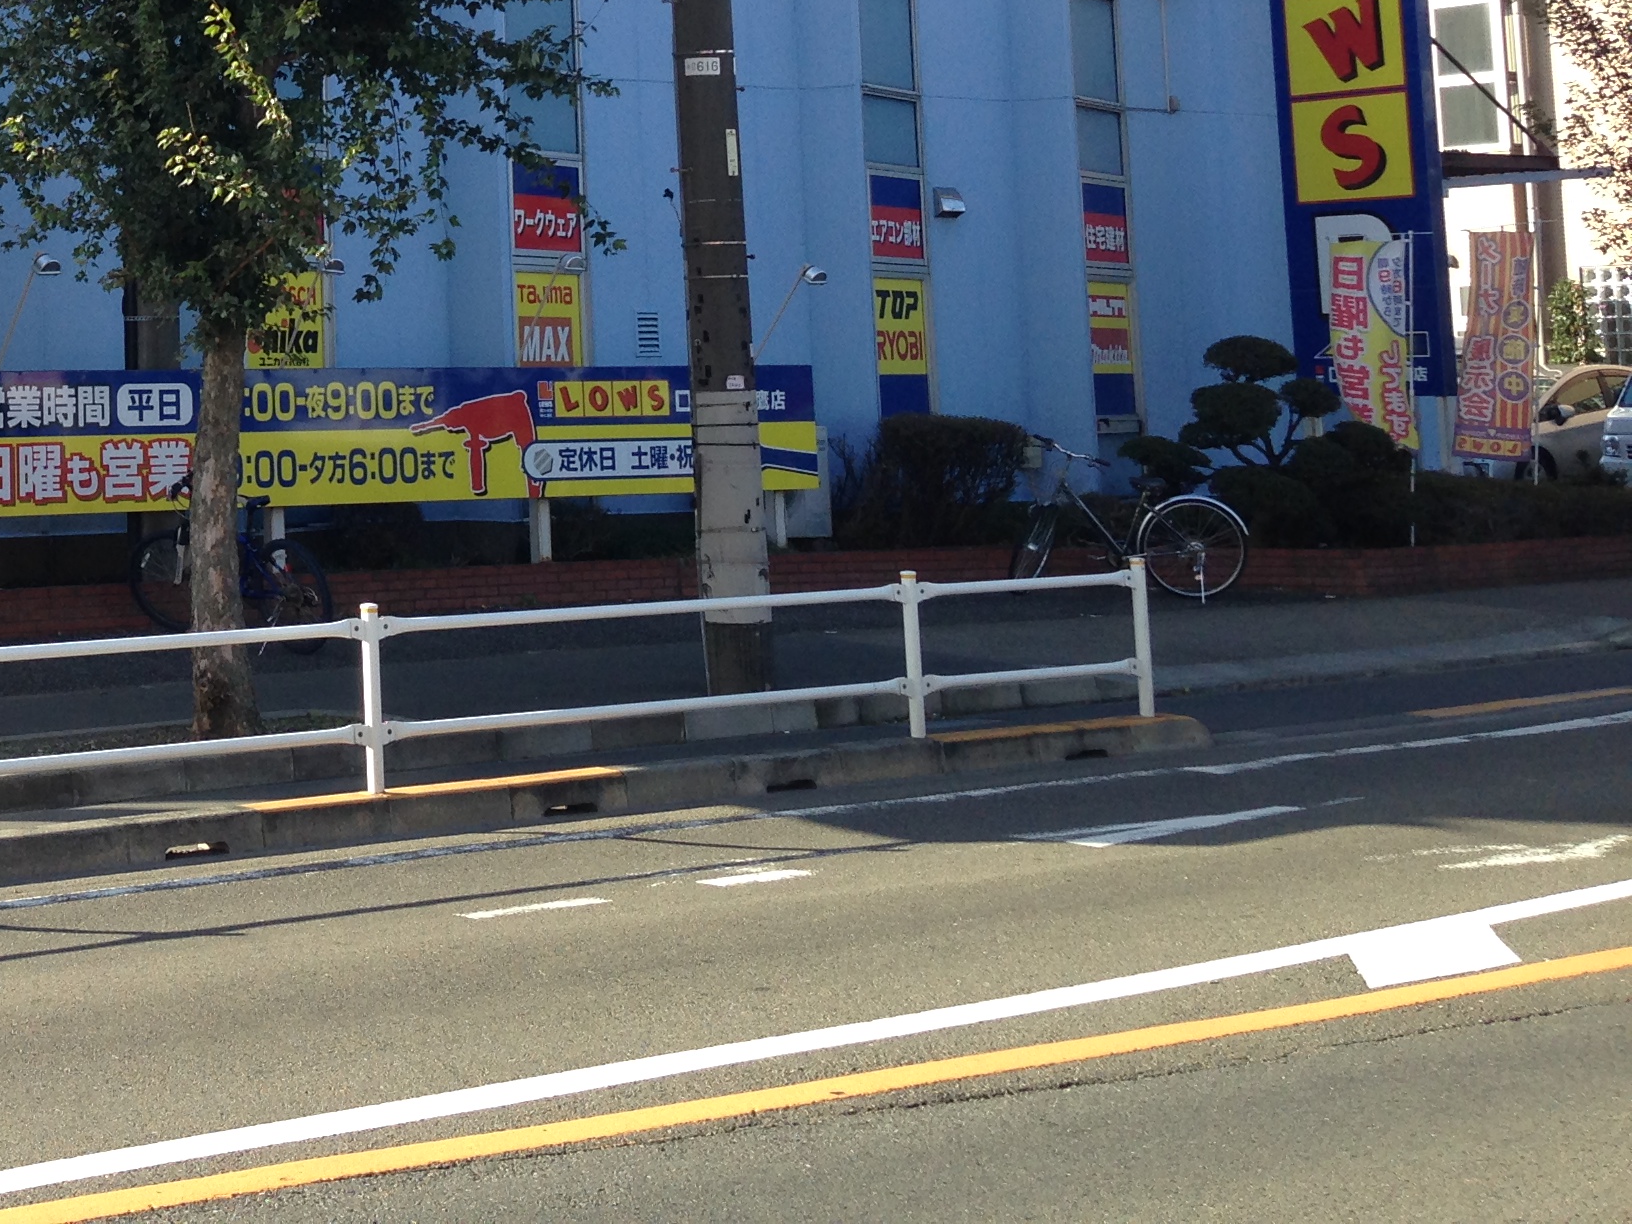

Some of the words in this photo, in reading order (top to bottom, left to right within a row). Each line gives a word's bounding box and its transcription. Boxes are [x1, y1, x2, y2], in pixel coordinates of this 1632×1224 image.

[514, 209, 577, 239] ワークウェア
[875, 289, 919, 320] TOP
[523, 325, 570, 363] MAX
[876, 330, 924, 361] RYOBI
[127, 389, 183, 422] 平日
[558, 384, 665, 413] LOWS
[558, 446, 616, 472] 定休日
